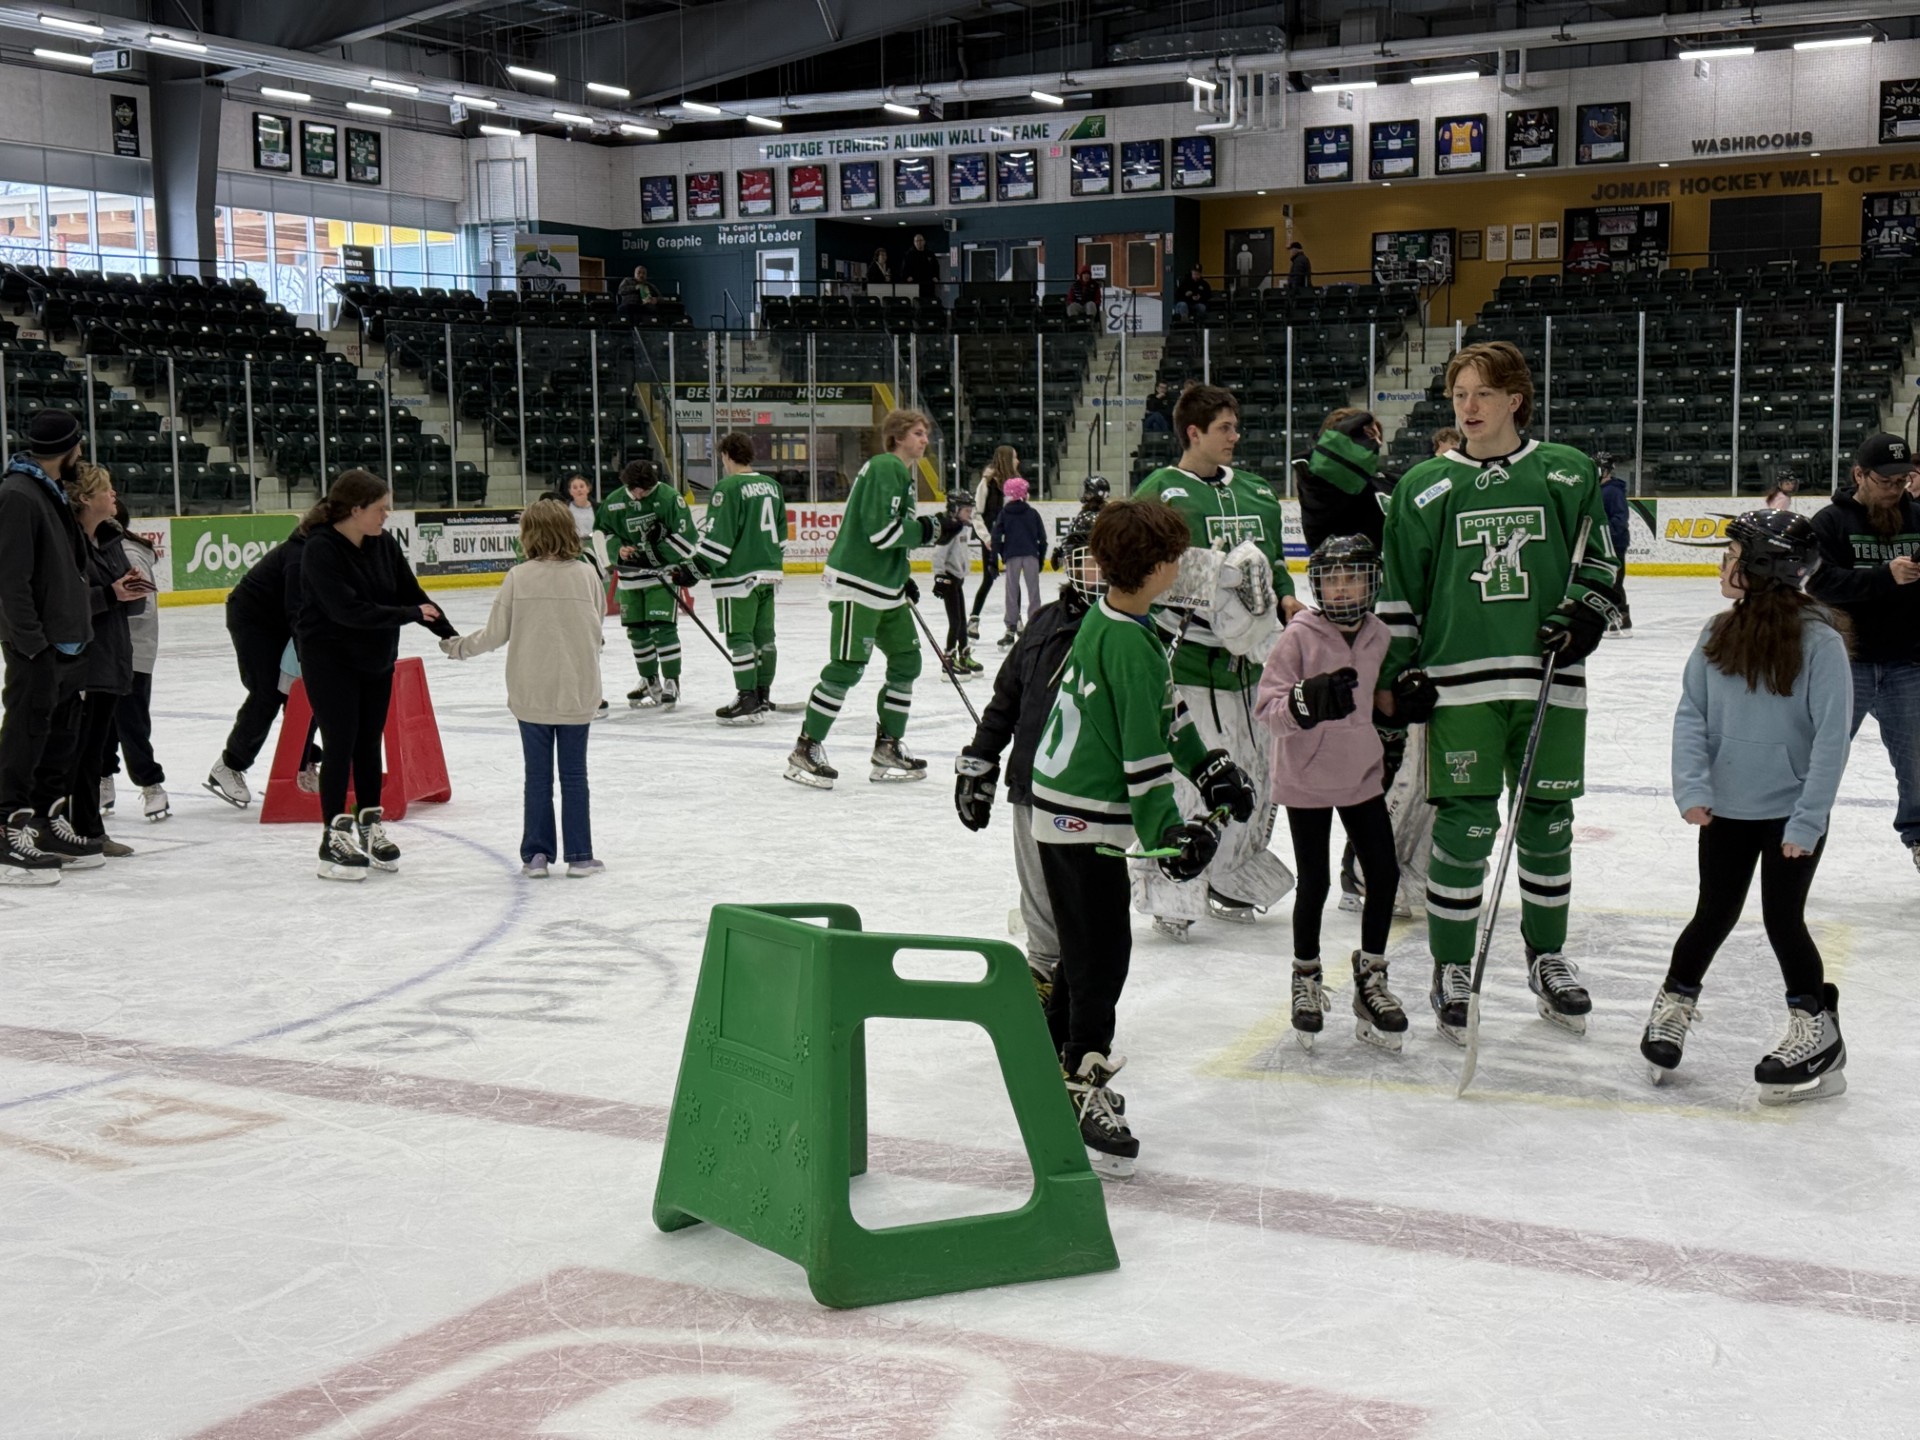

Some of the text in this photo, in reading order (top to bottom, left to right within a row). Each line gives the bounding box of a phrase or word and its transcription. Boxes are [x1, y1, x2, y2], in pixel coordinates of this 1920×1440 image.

[1902, 106, 1913, 114] 22
[766, 123, 1050, 160] PORTAGE TERRIERS ALUMNI WALL OF FAME
[1691, 130, 1813, 154] WASHROOMS
[1591, 162, 1920, 200] JONAIR HOCKEY WALL OF FA
[622, 235, 702, 251] Daily Graphic
[718, 229, 803, 245] Herald Leader
[686, 387, 725, 398] BEST
[729, 387, 763, 398] SEAT
[776, 388, 793, 398] the
[741, 482, 780, 500] MARSHLL
[678, 519, 686, 533] 3
[706, 517, 715, 533] 4
[761, 496, 779, 544] 4
[1212, 520, 1258, 530] PORTAGE
[1464, 514, 1535, 529] PORTAGE
[800, 530, 837, 541] CO-O
[1284, 526, 1301, 534] BES
[187, 532, 281, 574] Sobey
[453, 536, 517, 554] BUY ONLIN
[1196, 754, 1231, 788] CCM
[1536, 779, 1580, 790] CCM
[1466, 826, 1493, 838] SP
[1548, 818, 1570, 835] SP
